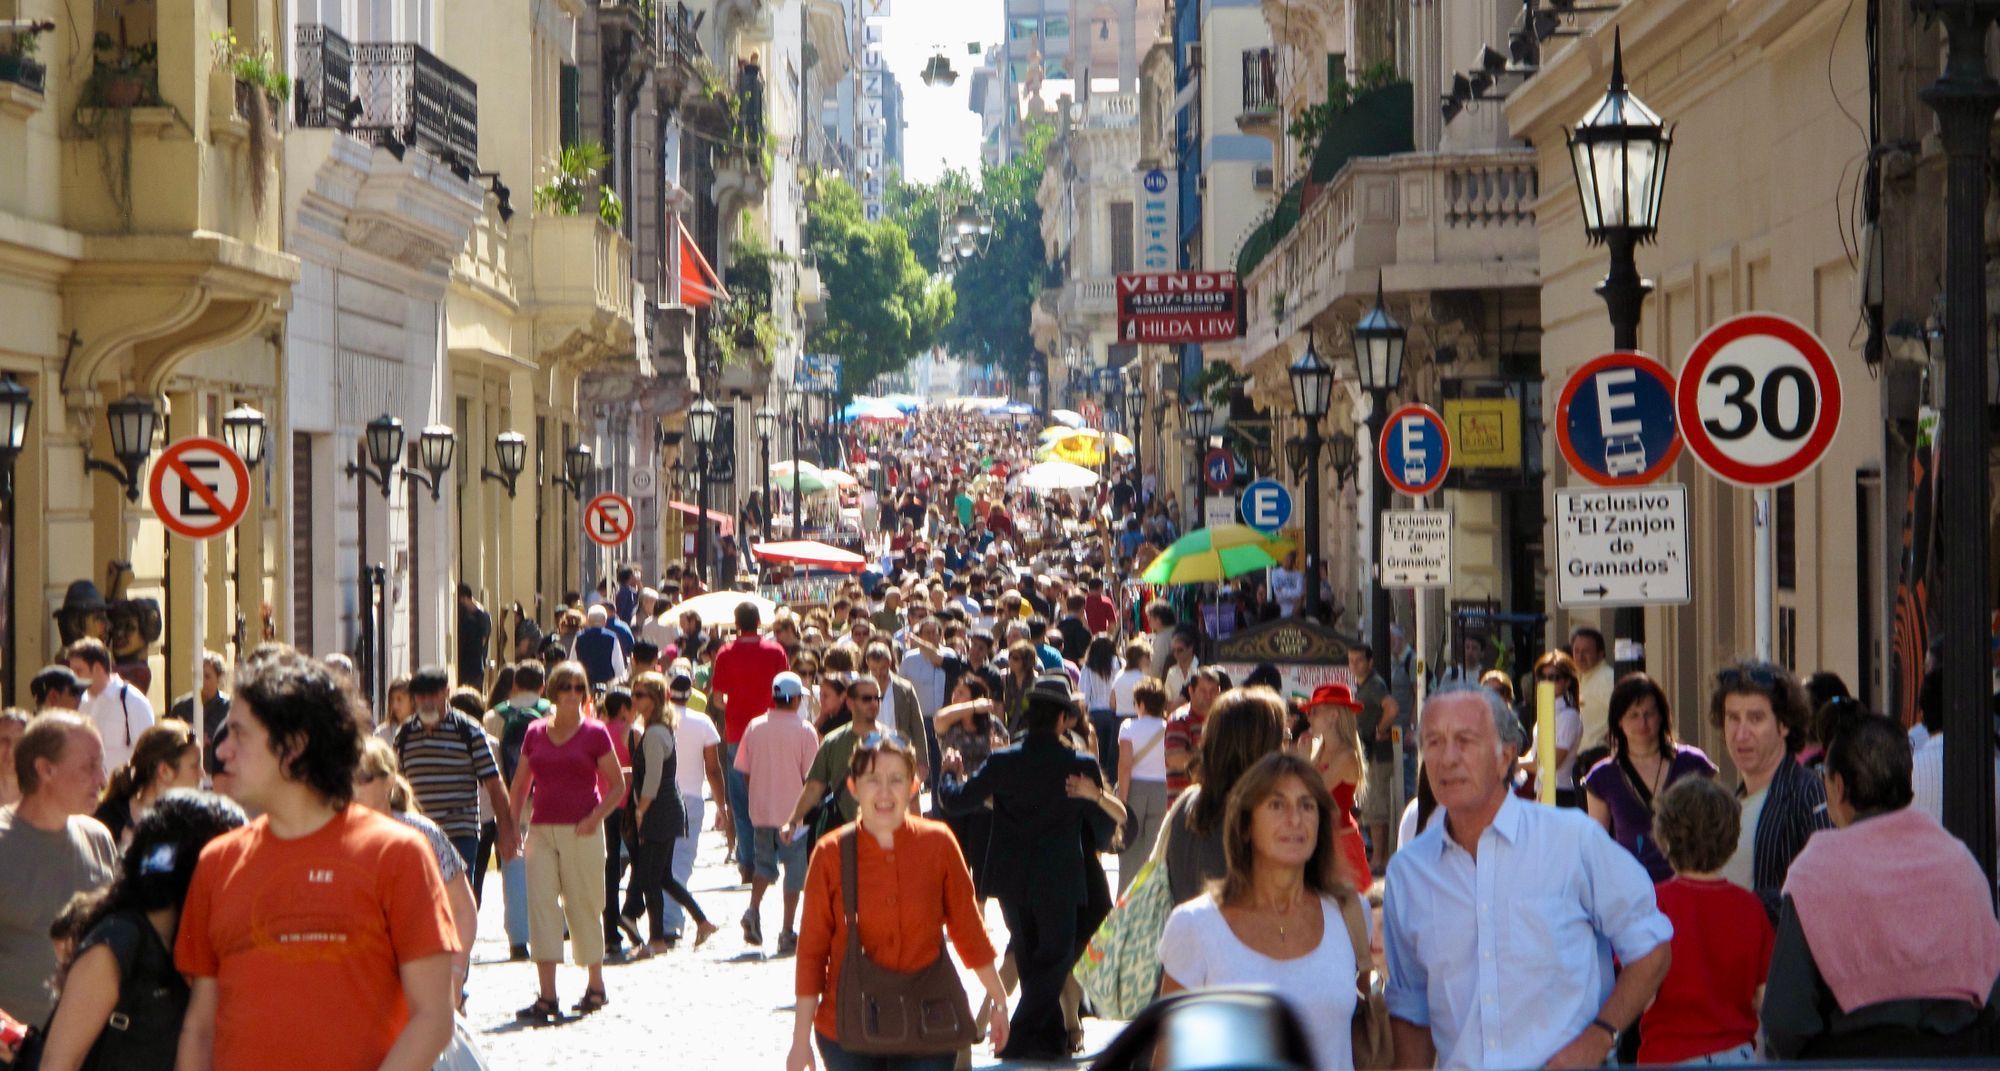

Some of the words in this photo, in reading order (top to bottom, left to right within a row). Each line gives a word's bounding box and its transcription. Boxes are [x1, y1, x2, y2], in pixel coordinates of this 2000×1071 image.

[1121, 273, 1233, 292] VENDE
[1142, 320, 1194, 337] HILDA
[1200, 318, 1235, 336] LEW
[1595, 368, 1643, 438] E
[1703, 364, 1817, 441] 30
[1402, 416, 1426, 459] E
[1254, 488, 1280, 526] E
[1568, 495, 1670, 514] Exclusivo
[1388, 514, 1443, 527] Exclusivo
[1604, 515, 1676, 539] Zanjon
[1407, 528, 1446, 543] Zanjon
[1409, 543, 1423, 555] de
[1609, 537, 1634, 555] de
[1387, 553, 1446, 569] Granados"
[1568, 550, 1678, 577] Granados"
[309, 869, 334, 883] LEE
